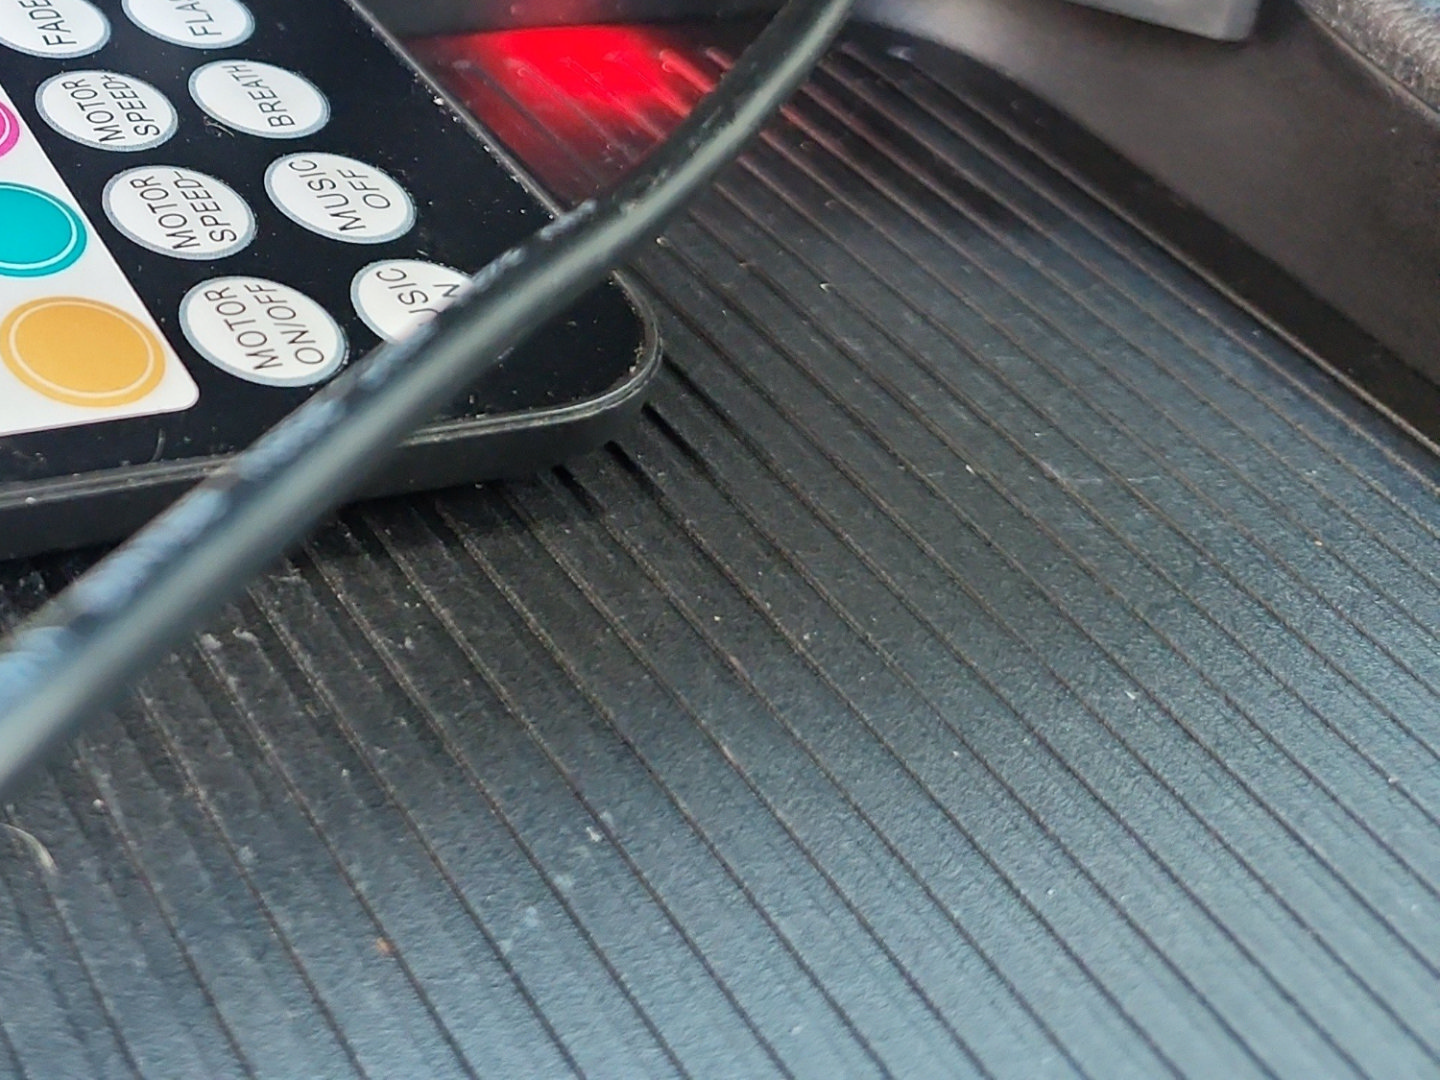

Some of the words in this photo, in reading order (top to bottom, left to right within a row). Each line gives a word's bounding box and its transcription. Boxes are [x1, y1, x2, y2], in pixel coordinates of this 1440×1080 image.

[61, 78, 127, 142] MOTOR
[101, 75, 161, 137] SPEED+
[221, 64, 296, 128] BREATH
[130, 175, 201, 250] MOTOR
[173, 171, 238, 243] SPEED-
[288, 158, 367, 232] MUSIC
[337, 168, 391, 209] OFF
[244, 283, 325, 365] ON/OFF
[375, 267, 440, 314] USIC
[204, 286, 283, 372] MOTOR
